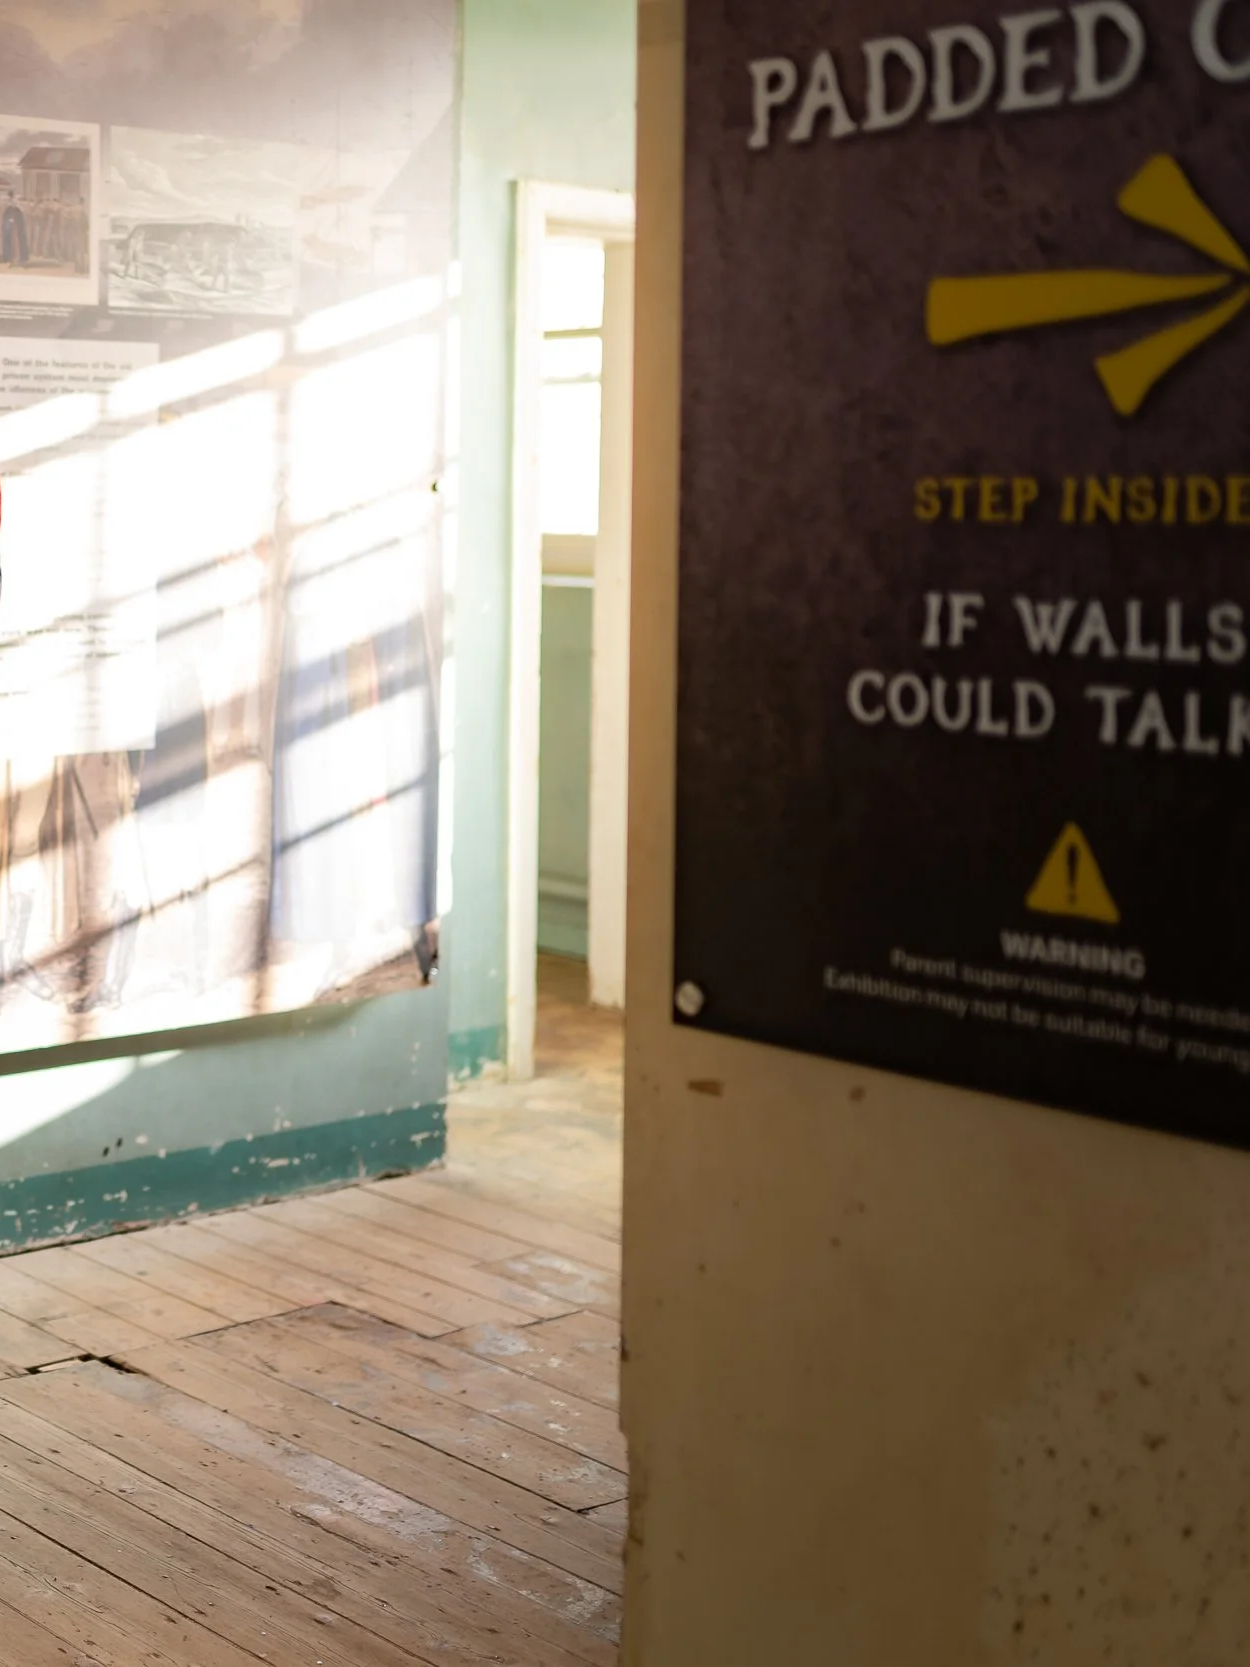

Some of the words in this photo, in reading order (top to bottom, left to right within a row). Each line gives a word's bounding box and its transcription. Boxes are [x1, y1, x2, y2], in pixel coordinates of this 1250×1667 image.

[747, 0, 1145, 149] PADDED
[913, 475, 1039, 522] STEP
[1059, 475, 1250, 525] INSIDE
[920, 590, 986, 649] IF
[1012, 593, 1247, 664] WALLS
[847, 668, 1055, 739] COULD
[889, 947, 957, 980] Parent
[961, 965, 1088, 1001] supervision
[1088, 986, 1140, 1019] may
[1140, 992, 1174, 1020] be
[1000, 929, 1146, 980] WARNING
[823, 964, 922, 1005] Exhibition
[924, 988, 969, 1021] may
[970, 999, 1010, 1023] not
[1011, 1002, 1042, 1029] be
[1043, 1012, 1132, 1045] suitable
[1136, 1023, 1170, 1050] for
